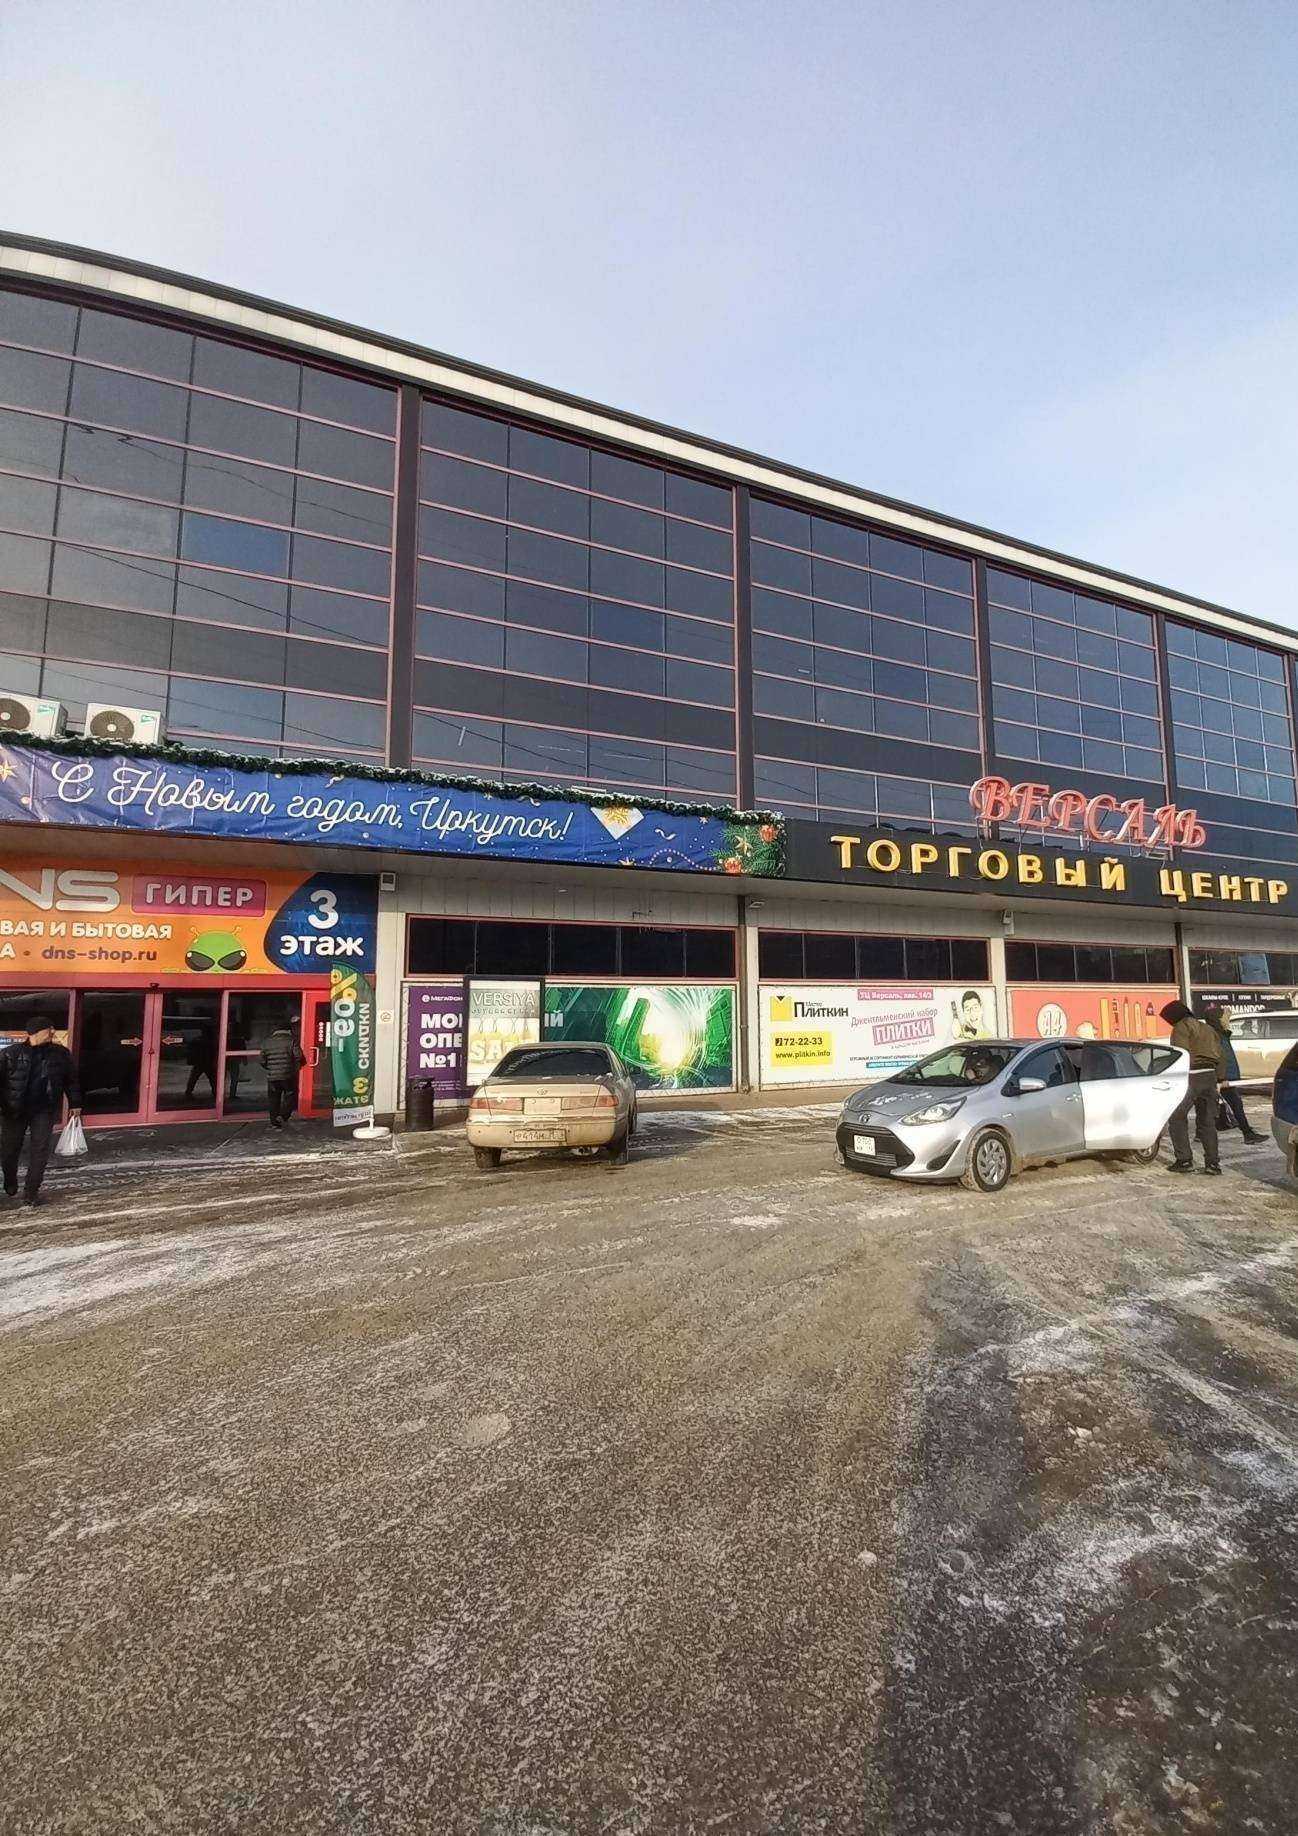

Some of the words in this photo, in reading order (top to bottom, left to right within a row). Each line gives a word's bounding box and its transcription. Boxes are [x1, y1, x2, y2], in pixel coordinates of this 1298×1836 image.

[52, 761, 94, 803] С
[107, 767, 276, 815] Новым
[287, 796, 402, 832] годом,
[410, 796, 574, 845] Иркутск!
[969, 776, 1208, 848] ВЕРСАЛЬ
[830, 835, 1126, 891] ТОРГОВЫЙ
[1159, 869, 1289, 904] ЦЕНТР
[145, 883, 253, 907] ГИПЕР
[308, 889, 339, 929] 3
[51, 921, 66, 937] И
[72, 922, 173, 939] БЫТОВАЯ
[41, 946, 157, 963] dns-shop.ru
[279, 935, 364, 956] этаж
[472, 992, 535, 1007] VERSIYA
[794, 1002, 849, 1017] Плиткин
[917, 1008, 938, 1018] набор
[875, 1018, 933, 1044] ПЛИТКИ
[784, 1037, 823, 1046] 72-22-33
[420, 1053, 457, 1068] №1
[775, 1050, 831, 1059] www.plitkin.info
